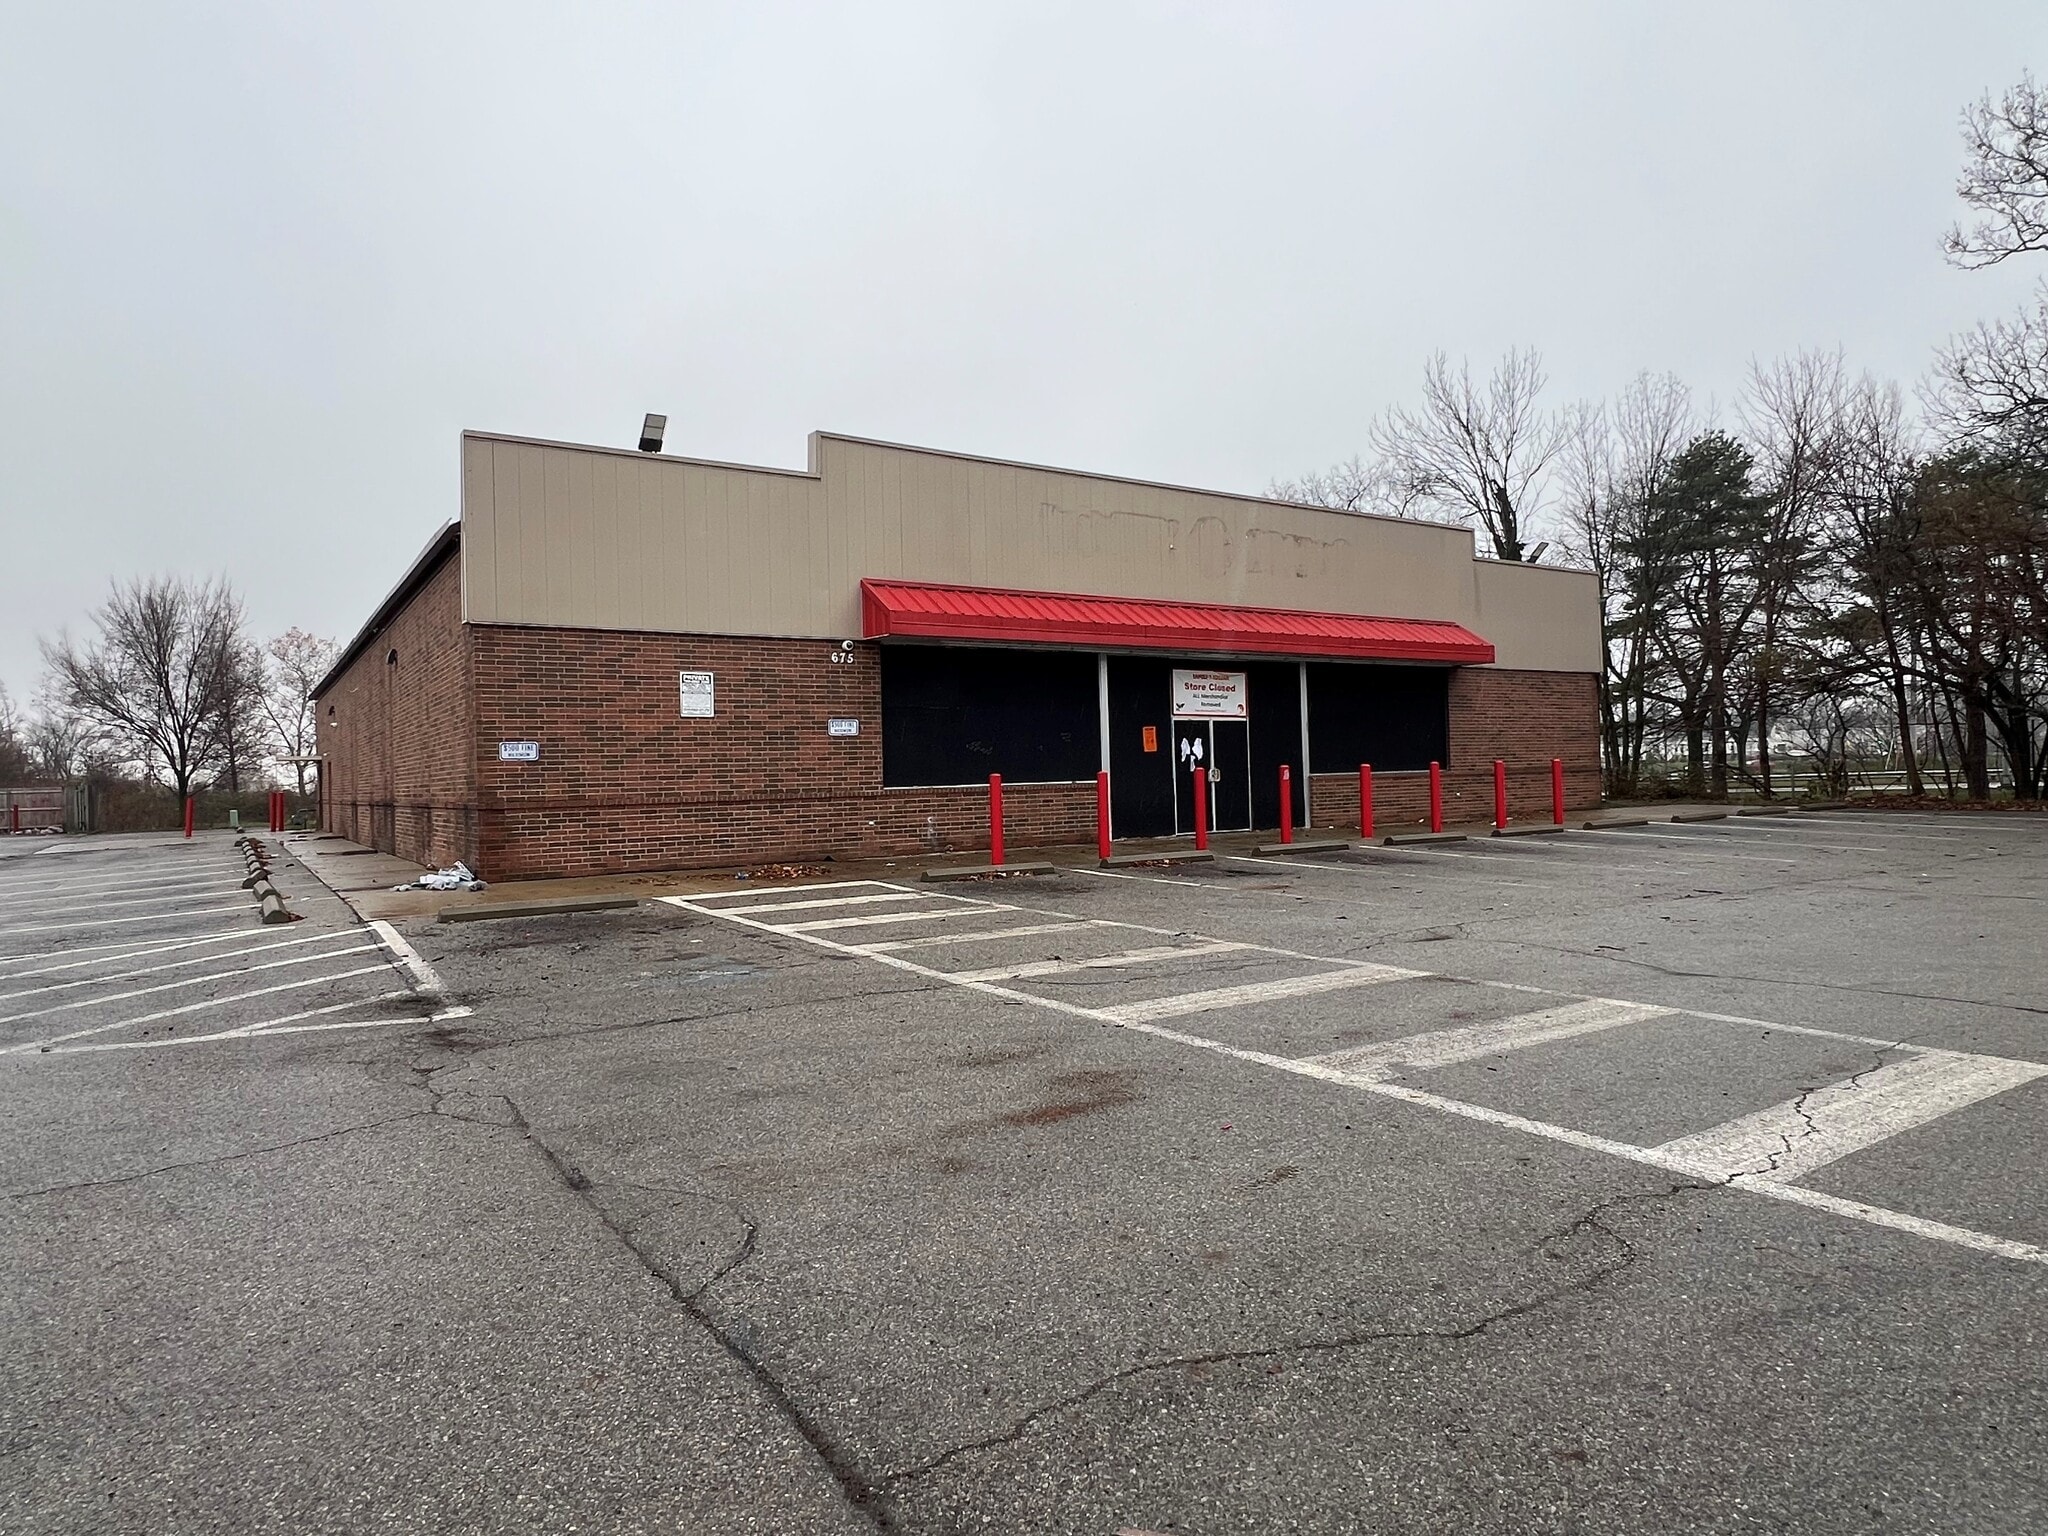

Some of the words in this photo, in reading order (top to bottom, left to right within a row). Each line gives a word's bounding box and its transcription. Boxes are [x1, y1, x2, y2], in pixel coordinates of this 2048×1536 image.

[831, 652, 854, 664] 675
[1184, 682, 1207, 691] Store
[1208, 683, 1236, 692] Closed
